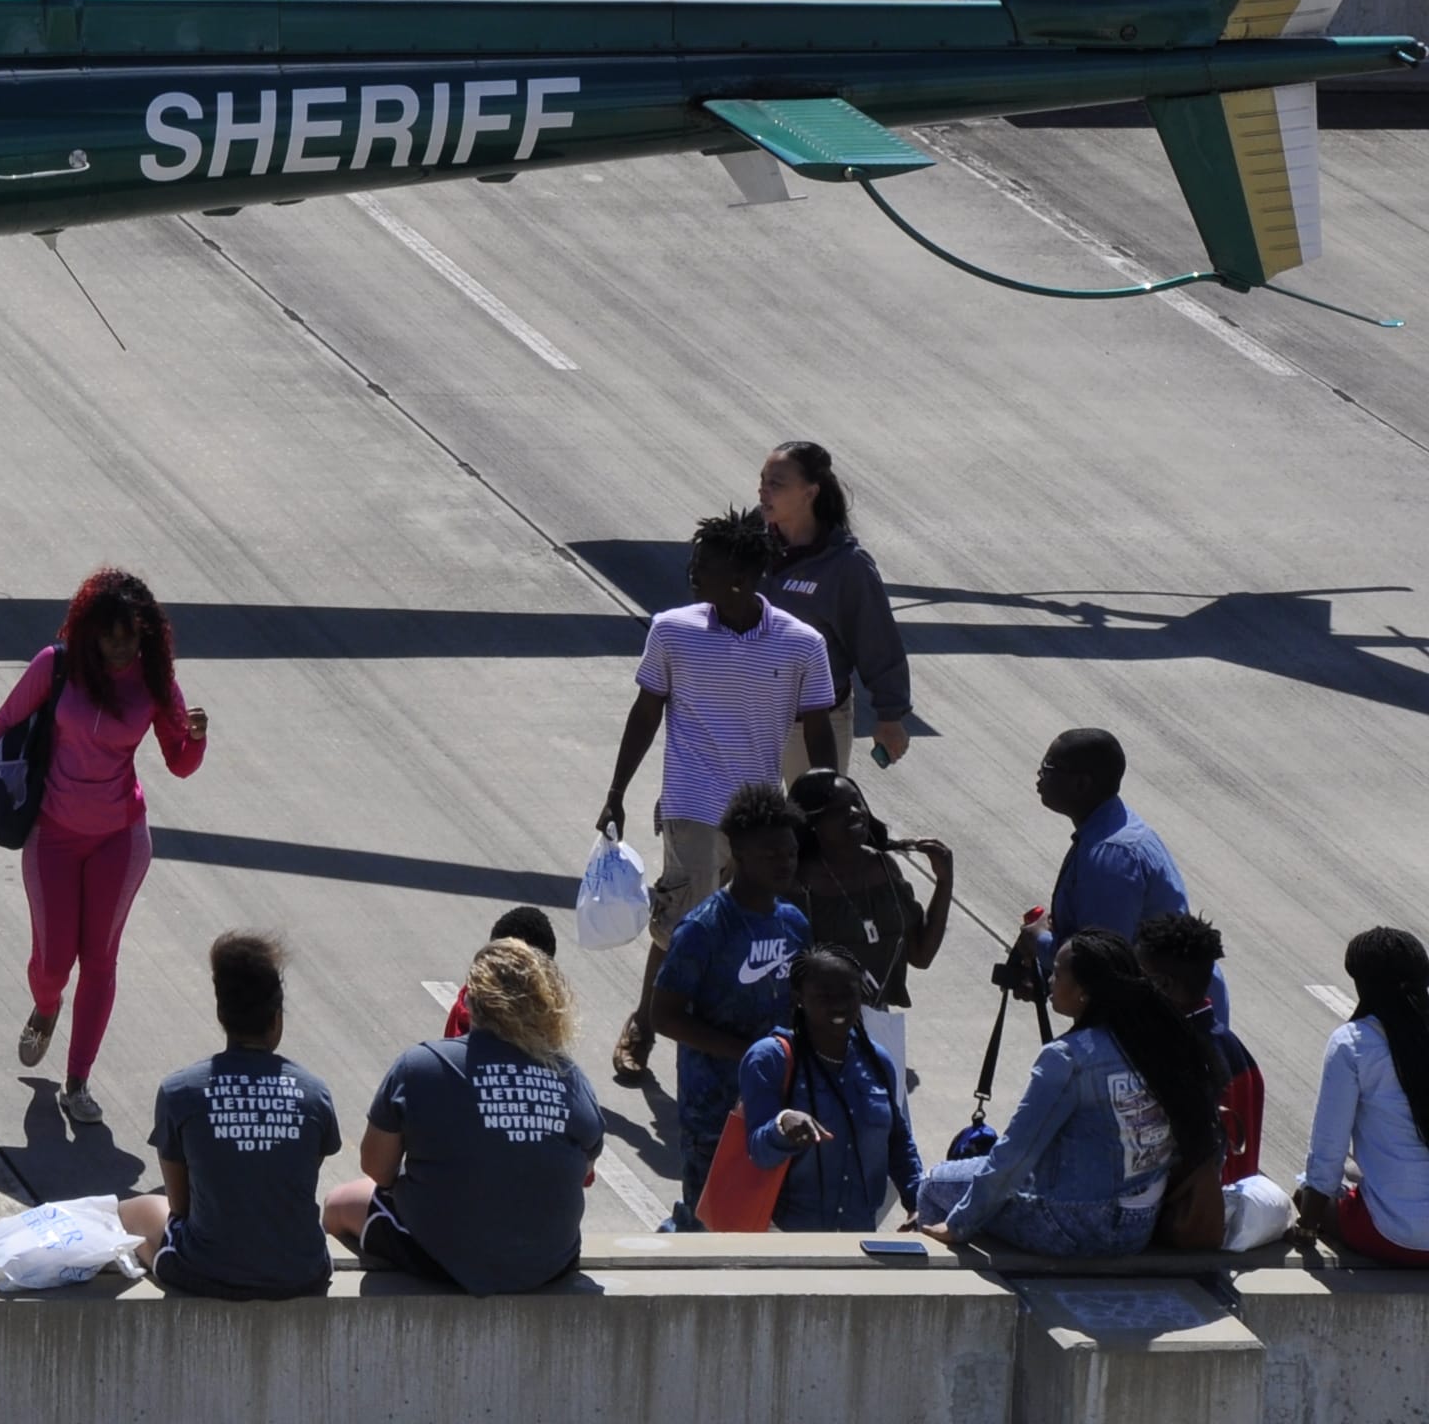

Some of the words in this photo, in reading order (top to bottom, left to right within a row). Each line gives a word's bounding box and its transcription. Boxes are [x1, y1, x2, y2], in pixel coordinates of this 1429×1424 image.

[140, 77, 580, 182] SHERIFF
[750, 938, 787, 963] NIKE
[523, 1065, 558, 1079] JUST
[256, 1076, 298, 1087] JUST
[472, 1076, 510, 1087] LIKE
[515, 1076, 567, 1092] EATING
[204, 1085, 241, 1098] LIKE
[248, 1086, 305, 1099] EATING
[480, 1088, 566, 1107] LETTUCE,
[212, 1098, 301, 1113] LETTUCE,
[477, 1103, 529, 1114] THERE
[535, 1105, 571, 1120] AIN'T
[208, 1112, 259, 1124] THERE
[265, 1113, 306, 1125] AIN'T
[484, 1116, 566, 1133] NOTHING
[214, 1125, 300, 1139] NOTHING
[507, 1131, 526, 1142] TO
[236, 1140, 255, 1152] TO
